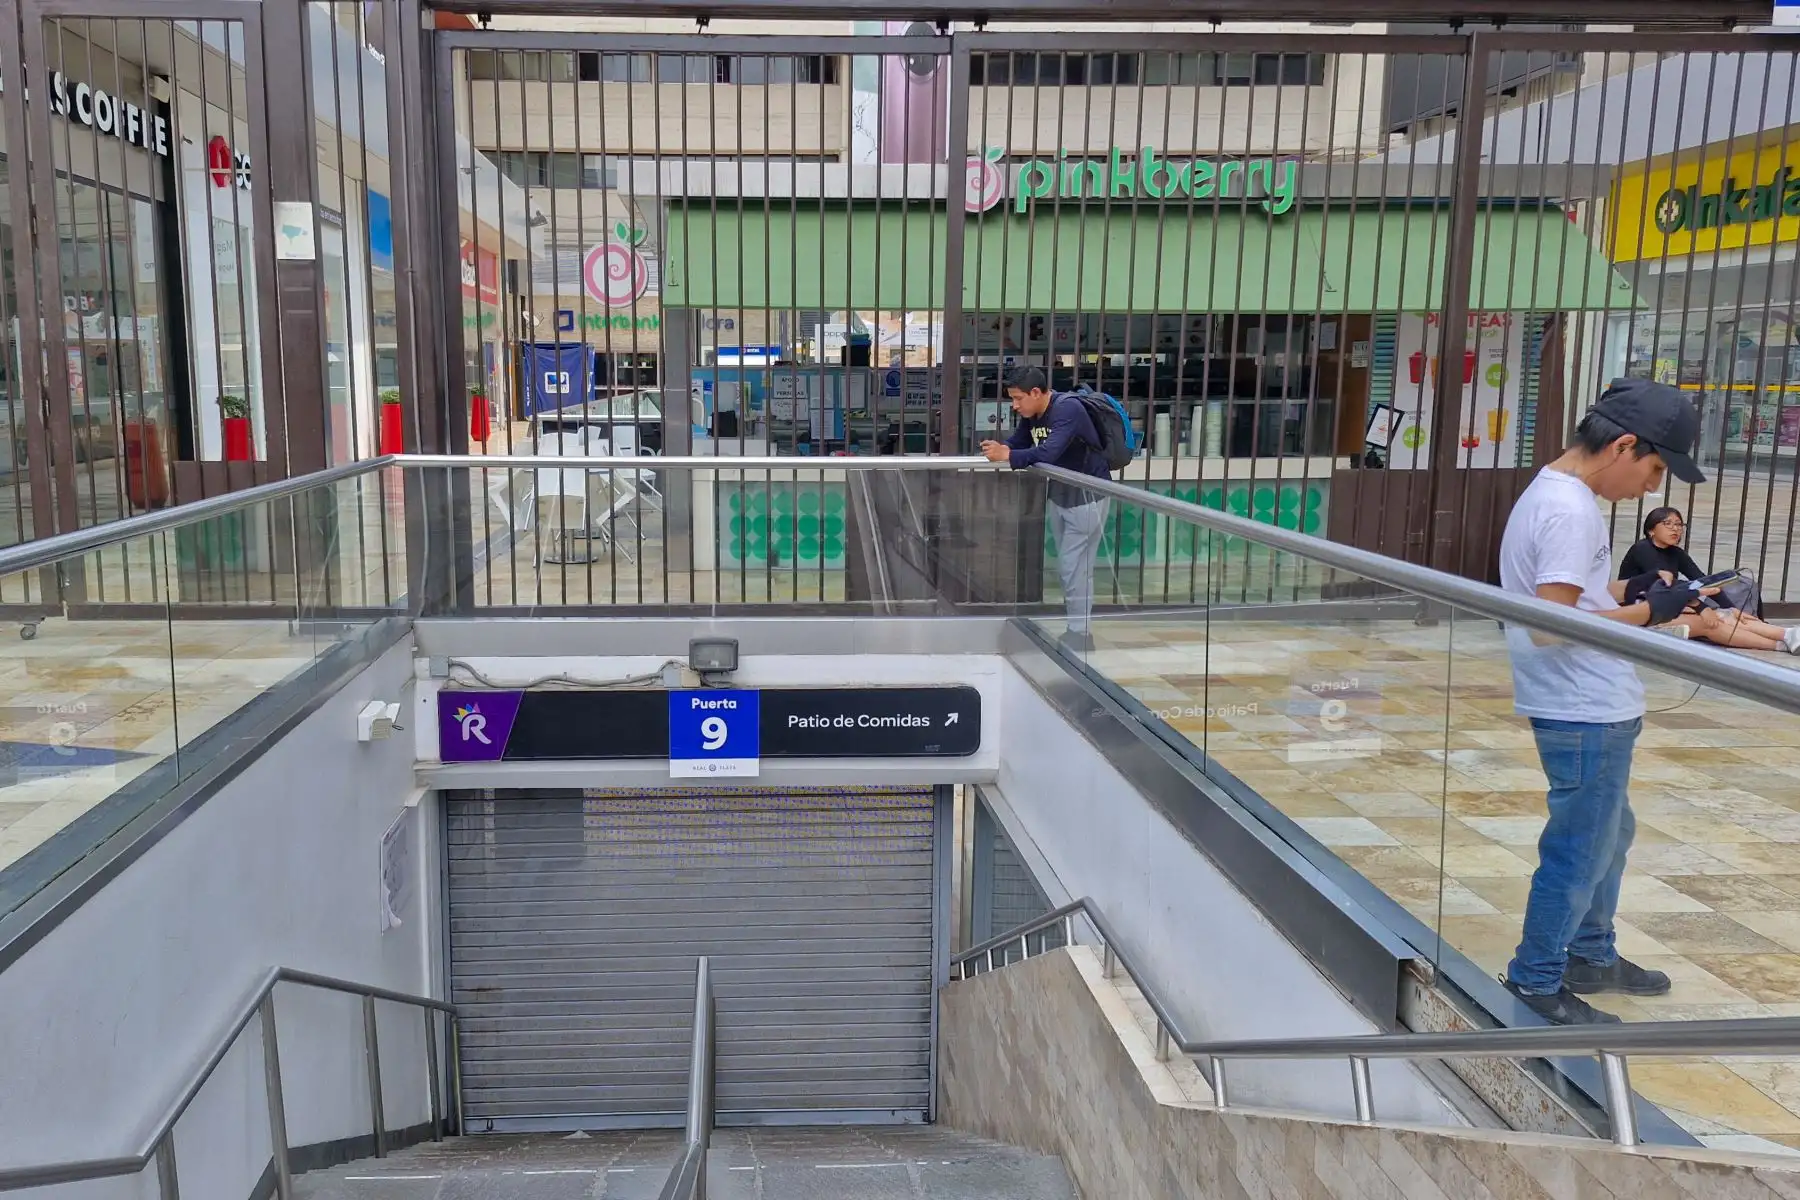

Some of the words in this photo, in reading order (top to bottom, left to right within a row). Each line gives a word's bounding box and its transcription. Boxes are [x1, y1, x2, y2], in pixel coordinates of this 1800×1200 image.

[1015, 145, 1296, 215] pinkberry
[691, 697, 737, 709] Puerta
[701, 716, 728, 750] 9
[788, 714, 830, 728] Patio
[833, 714, 854, 727] de
[857, 714, 930, 727] Comidas
